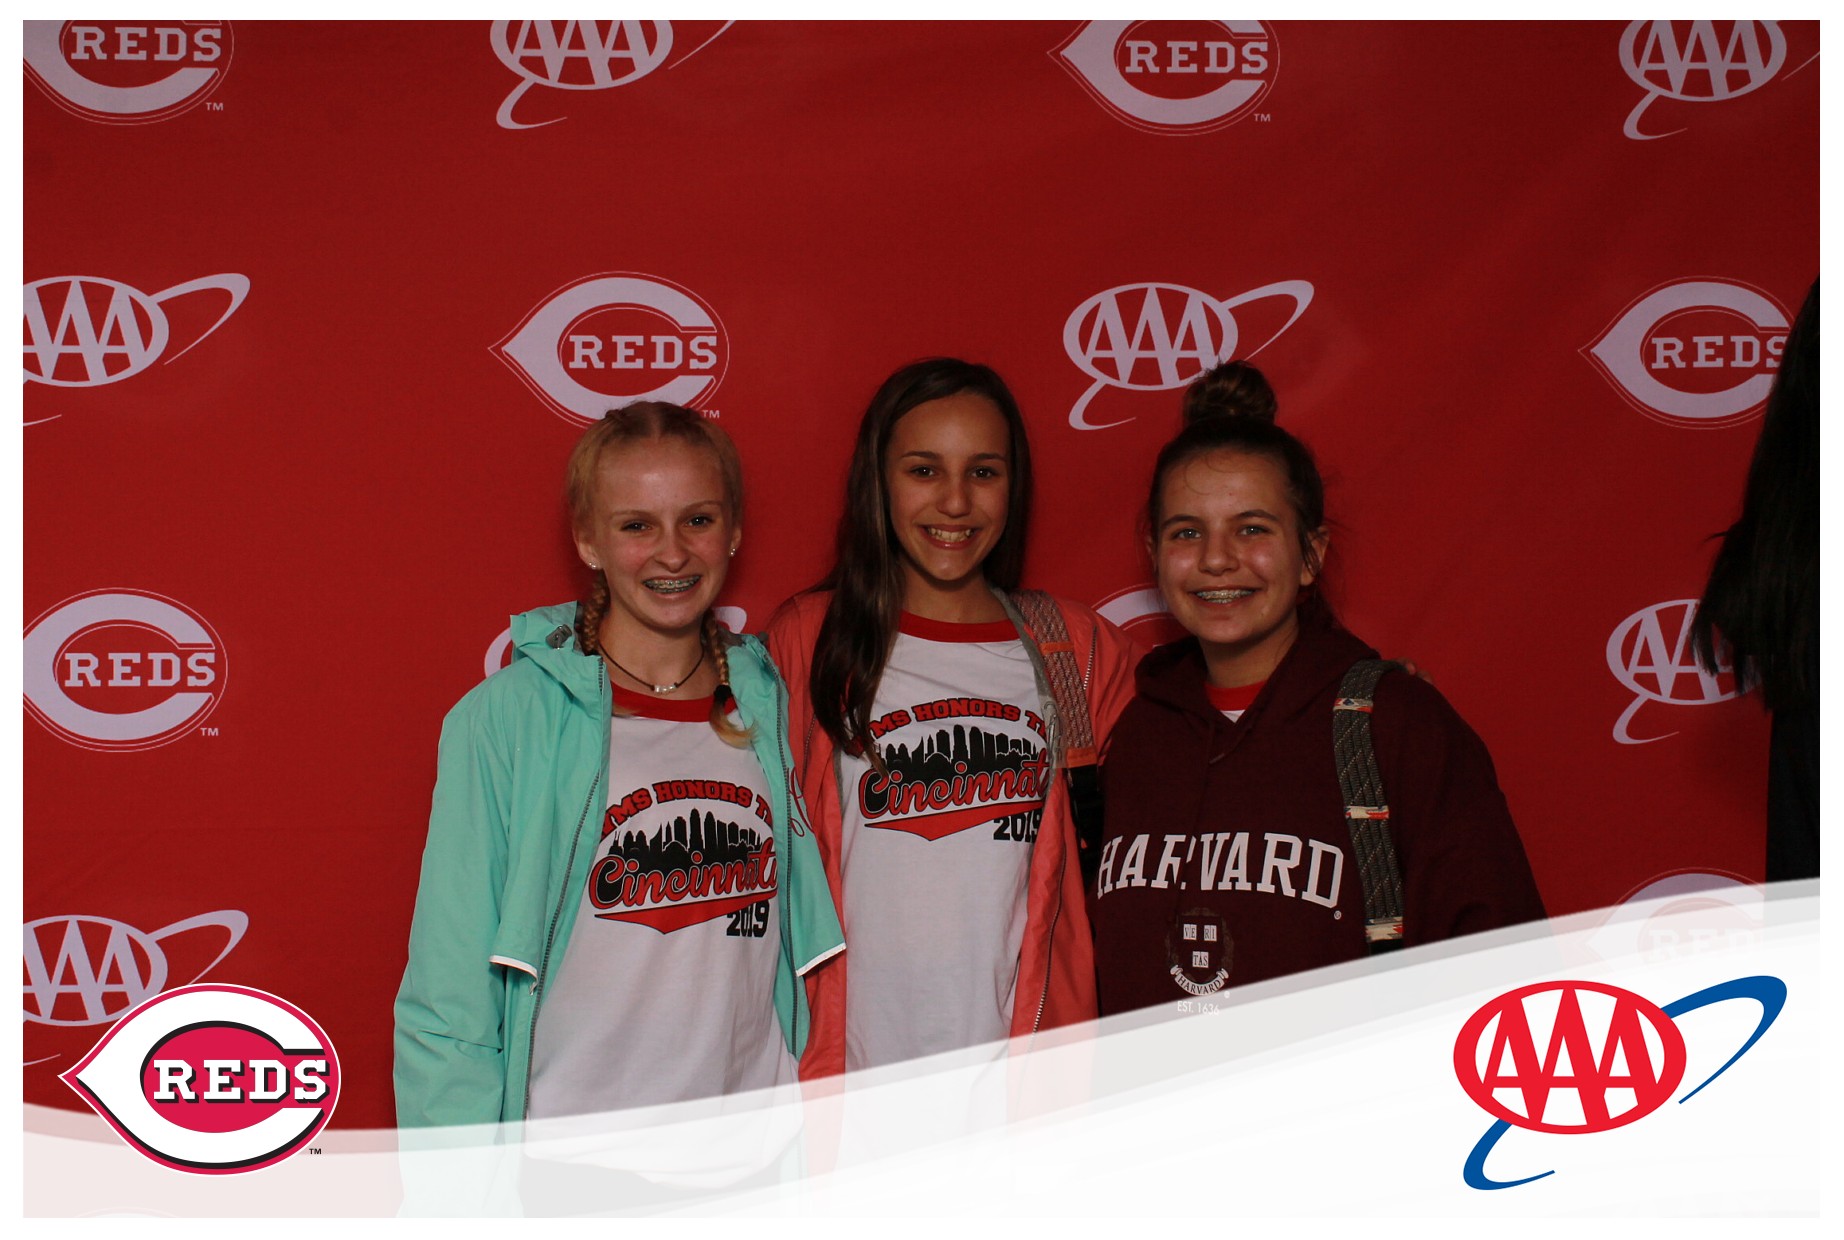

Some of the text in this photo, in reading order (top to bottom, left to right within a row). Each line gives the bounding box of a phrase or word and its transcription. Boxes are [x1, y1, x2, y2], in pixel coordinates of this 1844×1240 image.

[71, 26, 222, 62] REDS
[508, 20, 655, 86] AAA
[1125, 40, 1268, 74] REDS
[1636, 20, 1768, 98] AAA
[569, 335, 717, 369] REDS
[1083, 283, 1219, 388] AAA
[64, 652, 216, 687] REDS
[868, 709, 911, 739] MS
[911, 698, 1021, 722] HONORS
[652, 780, 753, 808] HONORS
[858, 748, 1049, 819] Cincinnat
[1097, 832, 1344, 909] HARVARD
[727, 899, 770, 938] 2019
[1177, 976, 1222, 995] HARVARD
